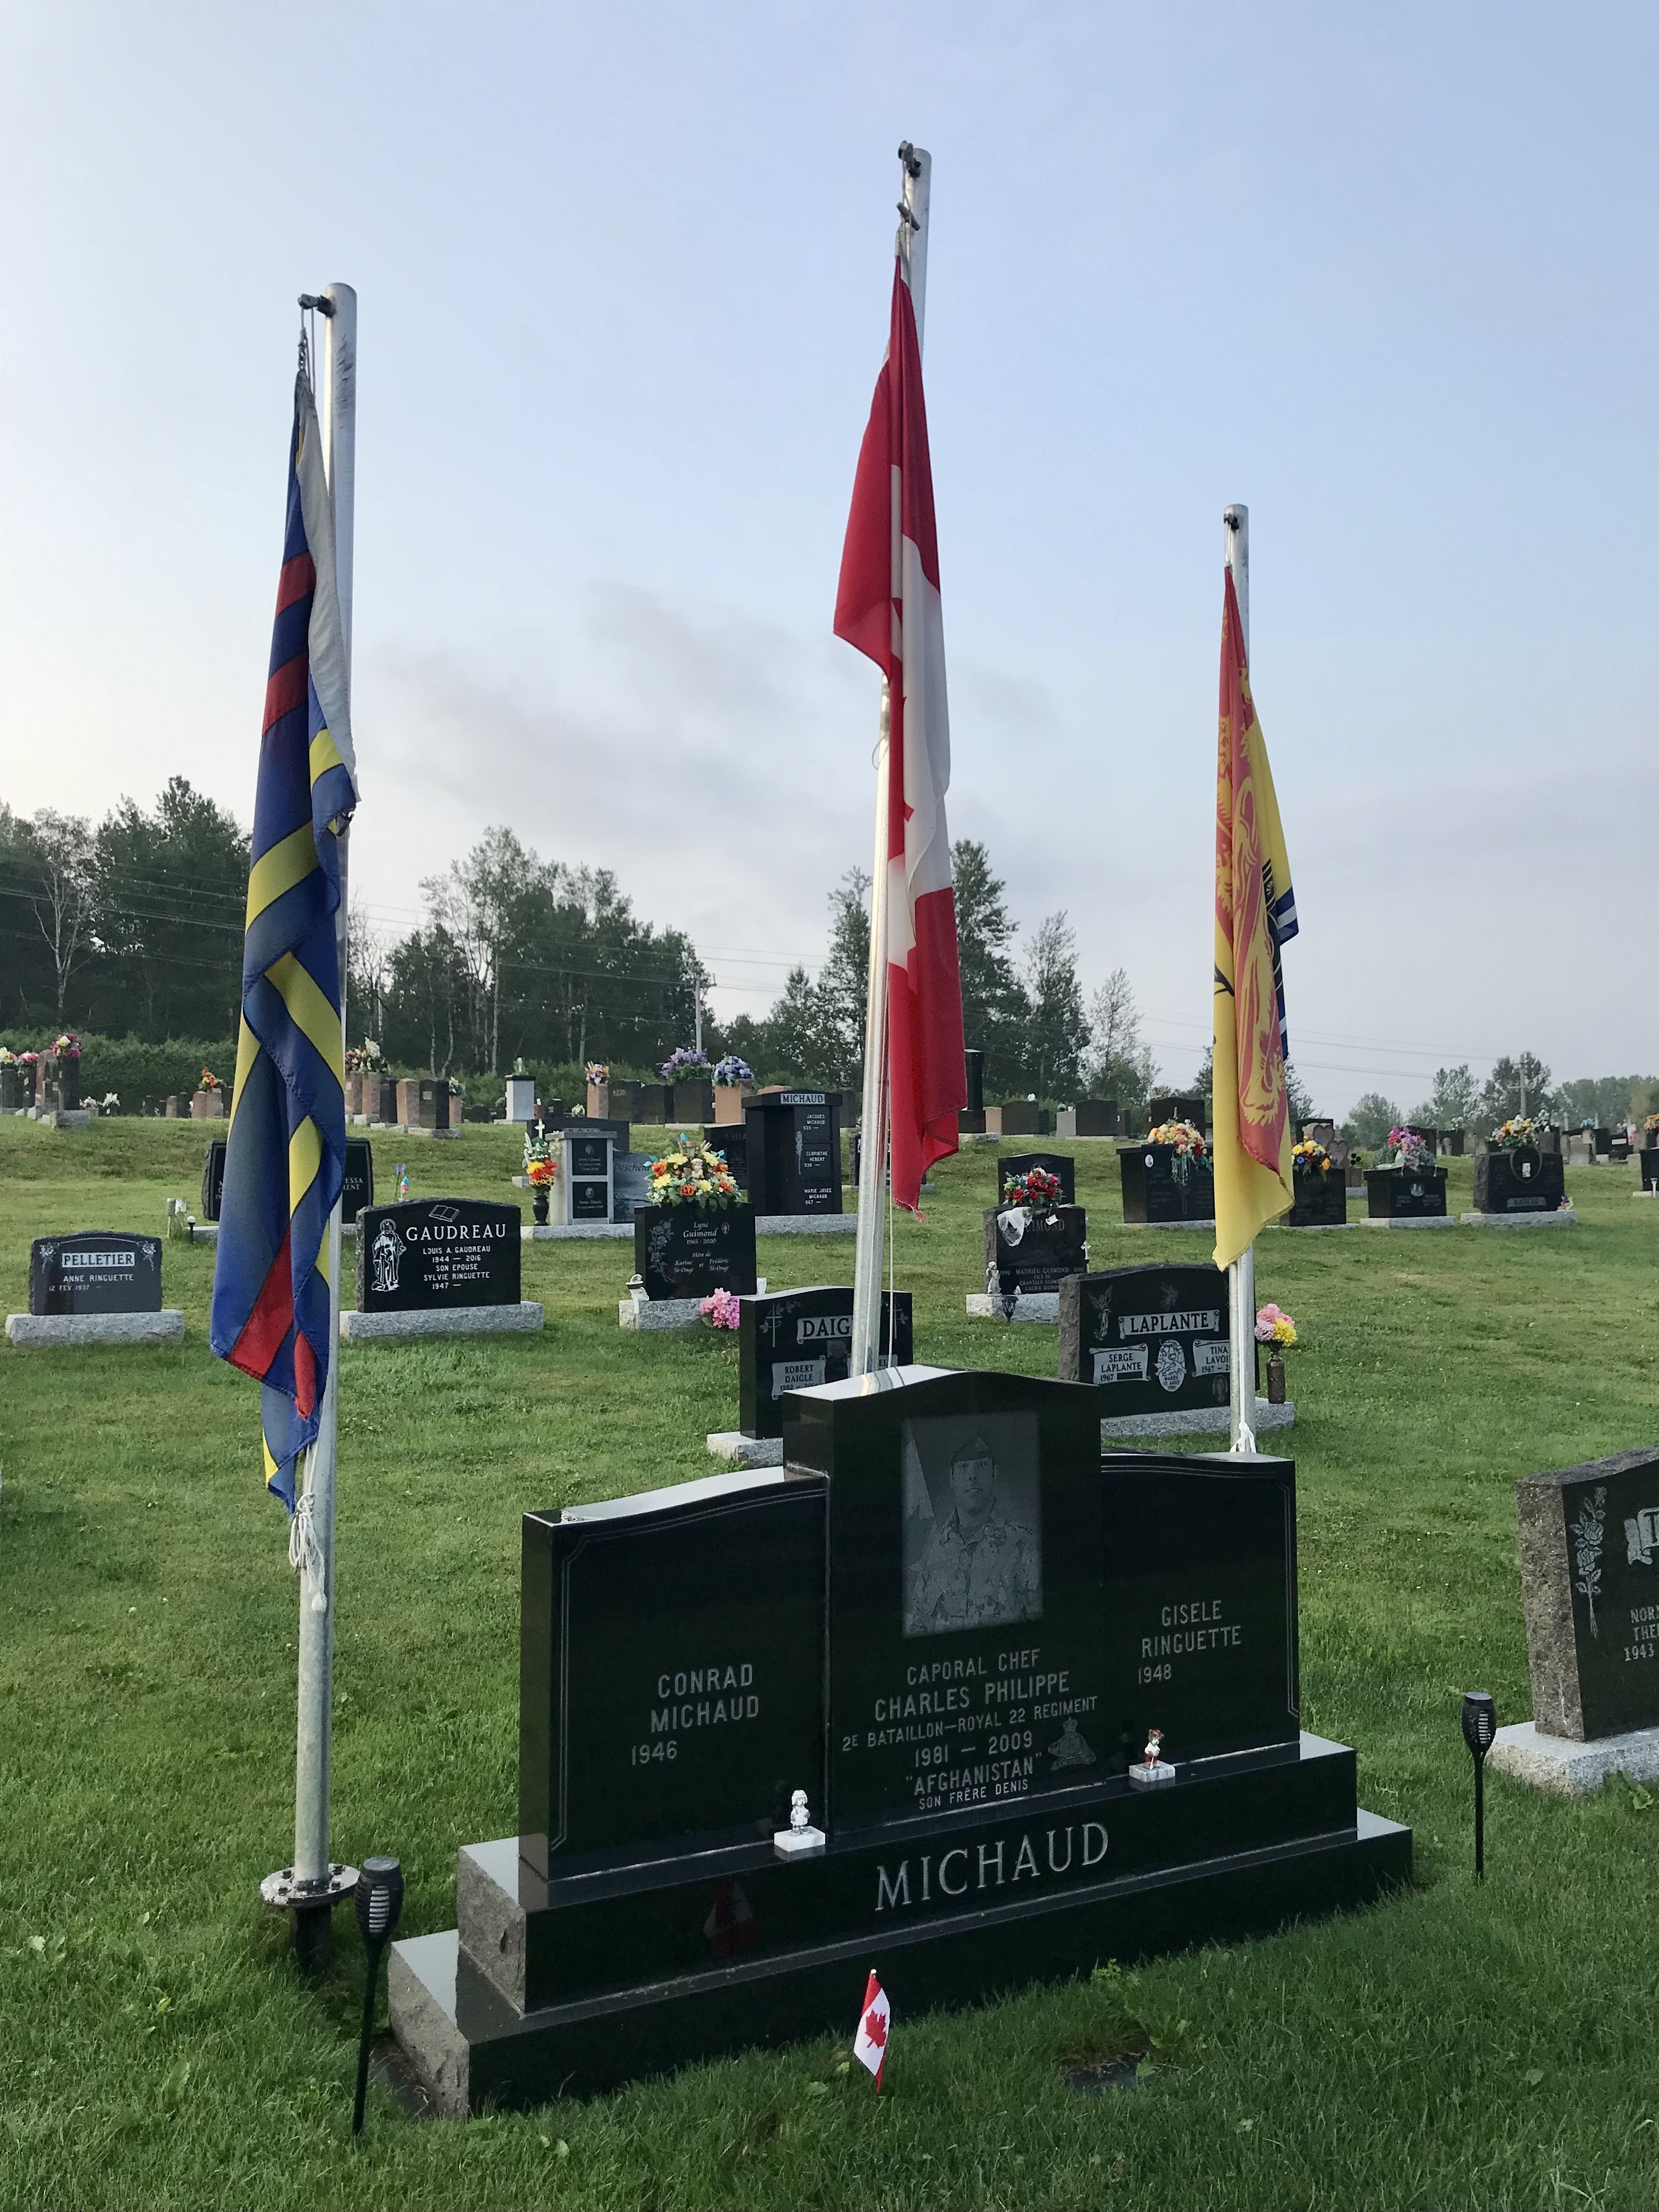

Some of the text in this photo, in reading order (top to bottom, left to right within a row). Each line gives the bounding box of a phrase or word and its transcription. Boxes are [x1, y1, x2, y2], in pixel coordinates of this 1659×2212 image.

[782, 1094, 823, 1103] MICHAUD
[406, 1224, 506, 1241] GAUDREAU
[683, 1228, 719, 1238] Guimond
[693, 1222, 709, 1231] Lyne
[64, 1254, 133, 1266] PELLETIER
[63, 1274, 84, 1283] ANNE
[803, 1317, 853, 1337] DAIG
[1130, 1312, 1209, 1333] LAPLANTE
[1109, 1353, 1133, 1363] SERGE
[1206, 1355, 1230, 1364] LAVOI
[1210, 1346, 1229, 1355] TINA
[785, 1364, 814, 1374] ROBERT
[1100, 1373, 1114, 1381] 1967
[1101, 1362, 1142, 1373] LAPLANTE
[785, 1373, 814, 1383] DAIGLE
[1161, 1599, 1222, 1627] GISELE
[1142, 1624, 1242, 1658] RINGUETTE
[1624, 1643, 1655, 1663] 1943
[907, 1648, 1041, 1685] CAPORAL CHEF
[1138, 1663, 1172, 1684] 1948
[658, 1663, 753, 1699] CONRAD
[874, 1671, 1070, 1722] CHARLES PHILIPPE
[651, 1695, 759, 1734] MICHAUD
[1009, 1708, 1026, 1724] 22
[1034, 1695, 1097, 1719] REGIMENT
[631, 1740, 678, 1765] 1946
[915, 1744, 949, 1768] 1981
[988, 1730, 1032, 1754] 2009
[919, 1796, 941, 1810] SON
[995, 1779, 1029, 1795] DENIS
[874, 1822, 1109, 1911] MICHAUD
